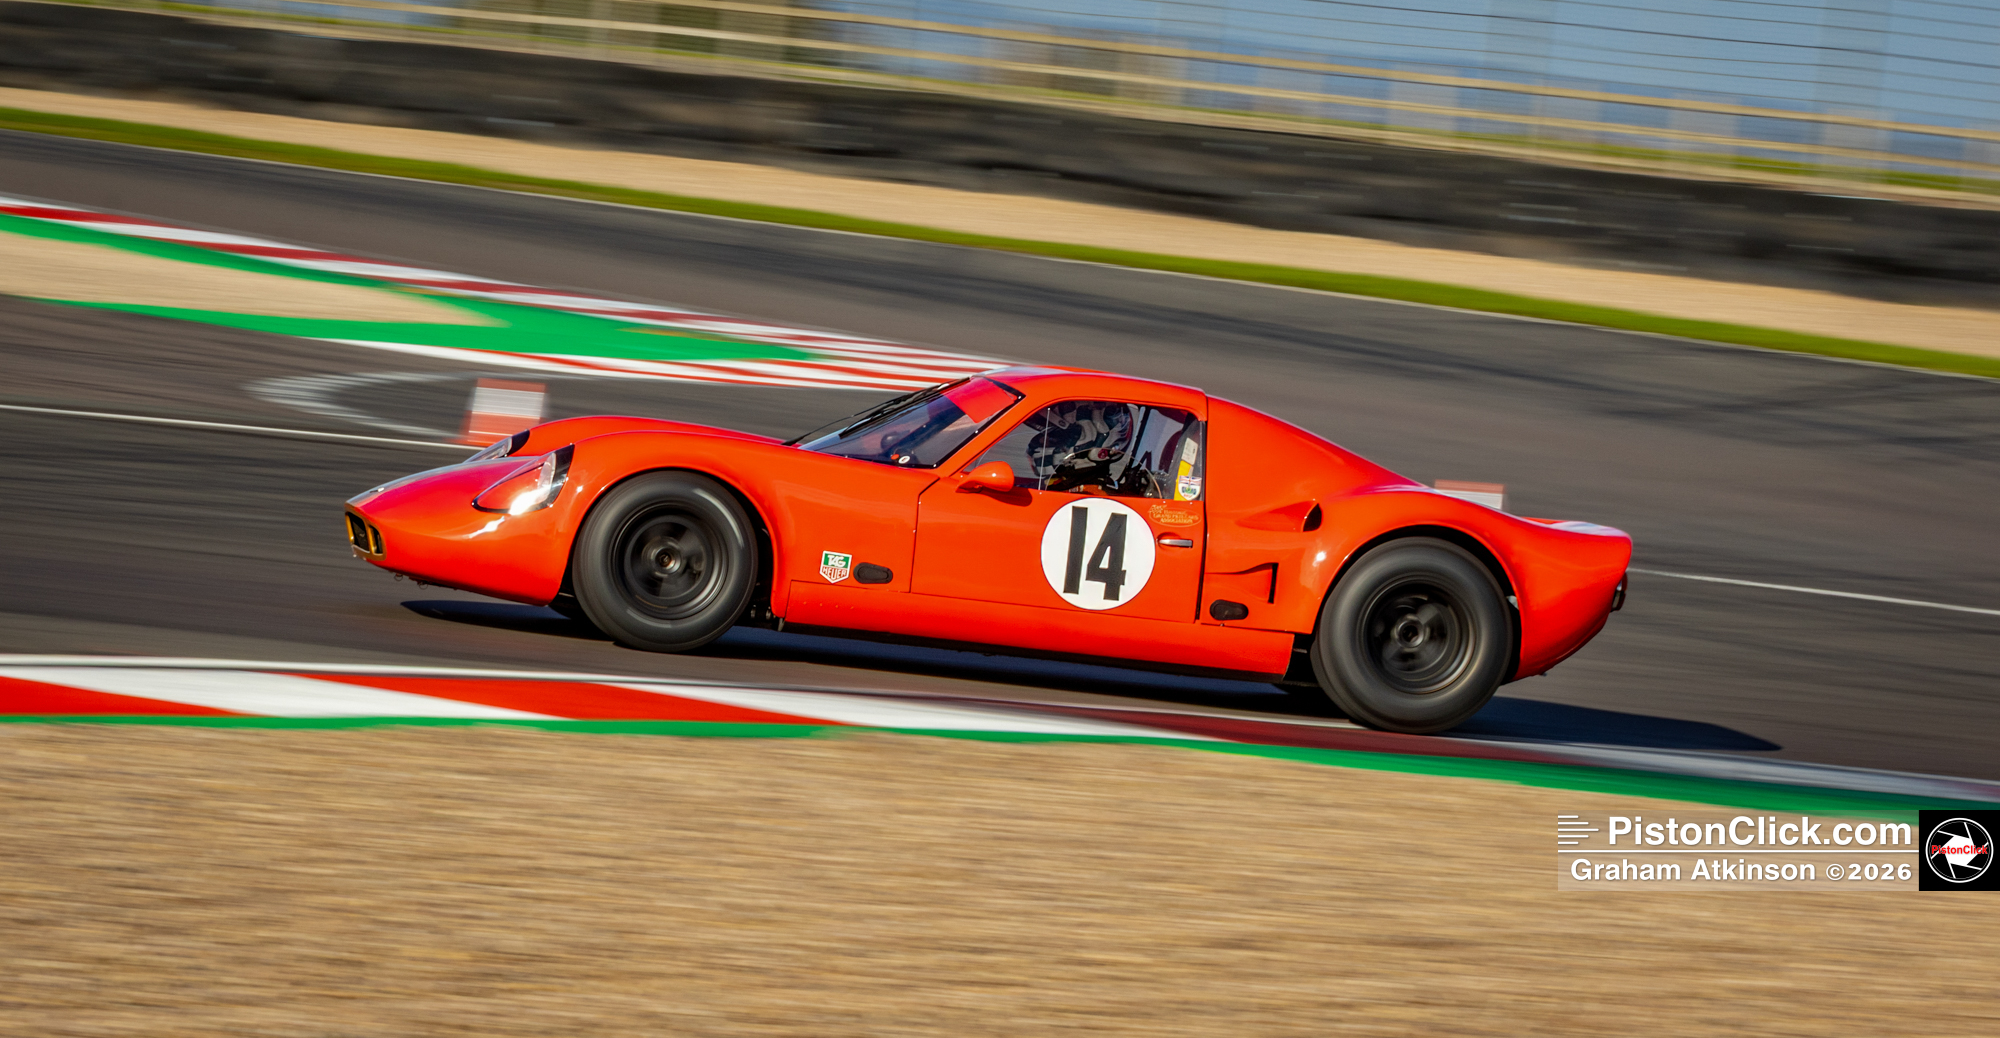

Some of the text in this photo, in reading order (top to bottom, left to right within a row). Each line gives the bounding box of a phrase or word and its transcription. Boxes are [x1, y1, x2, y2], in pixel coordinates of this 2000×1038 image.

[1064, 506, 1127, 600] 14
[827, 554, 846, 568] TAG
[822, 566, 848, 580] HEUER
